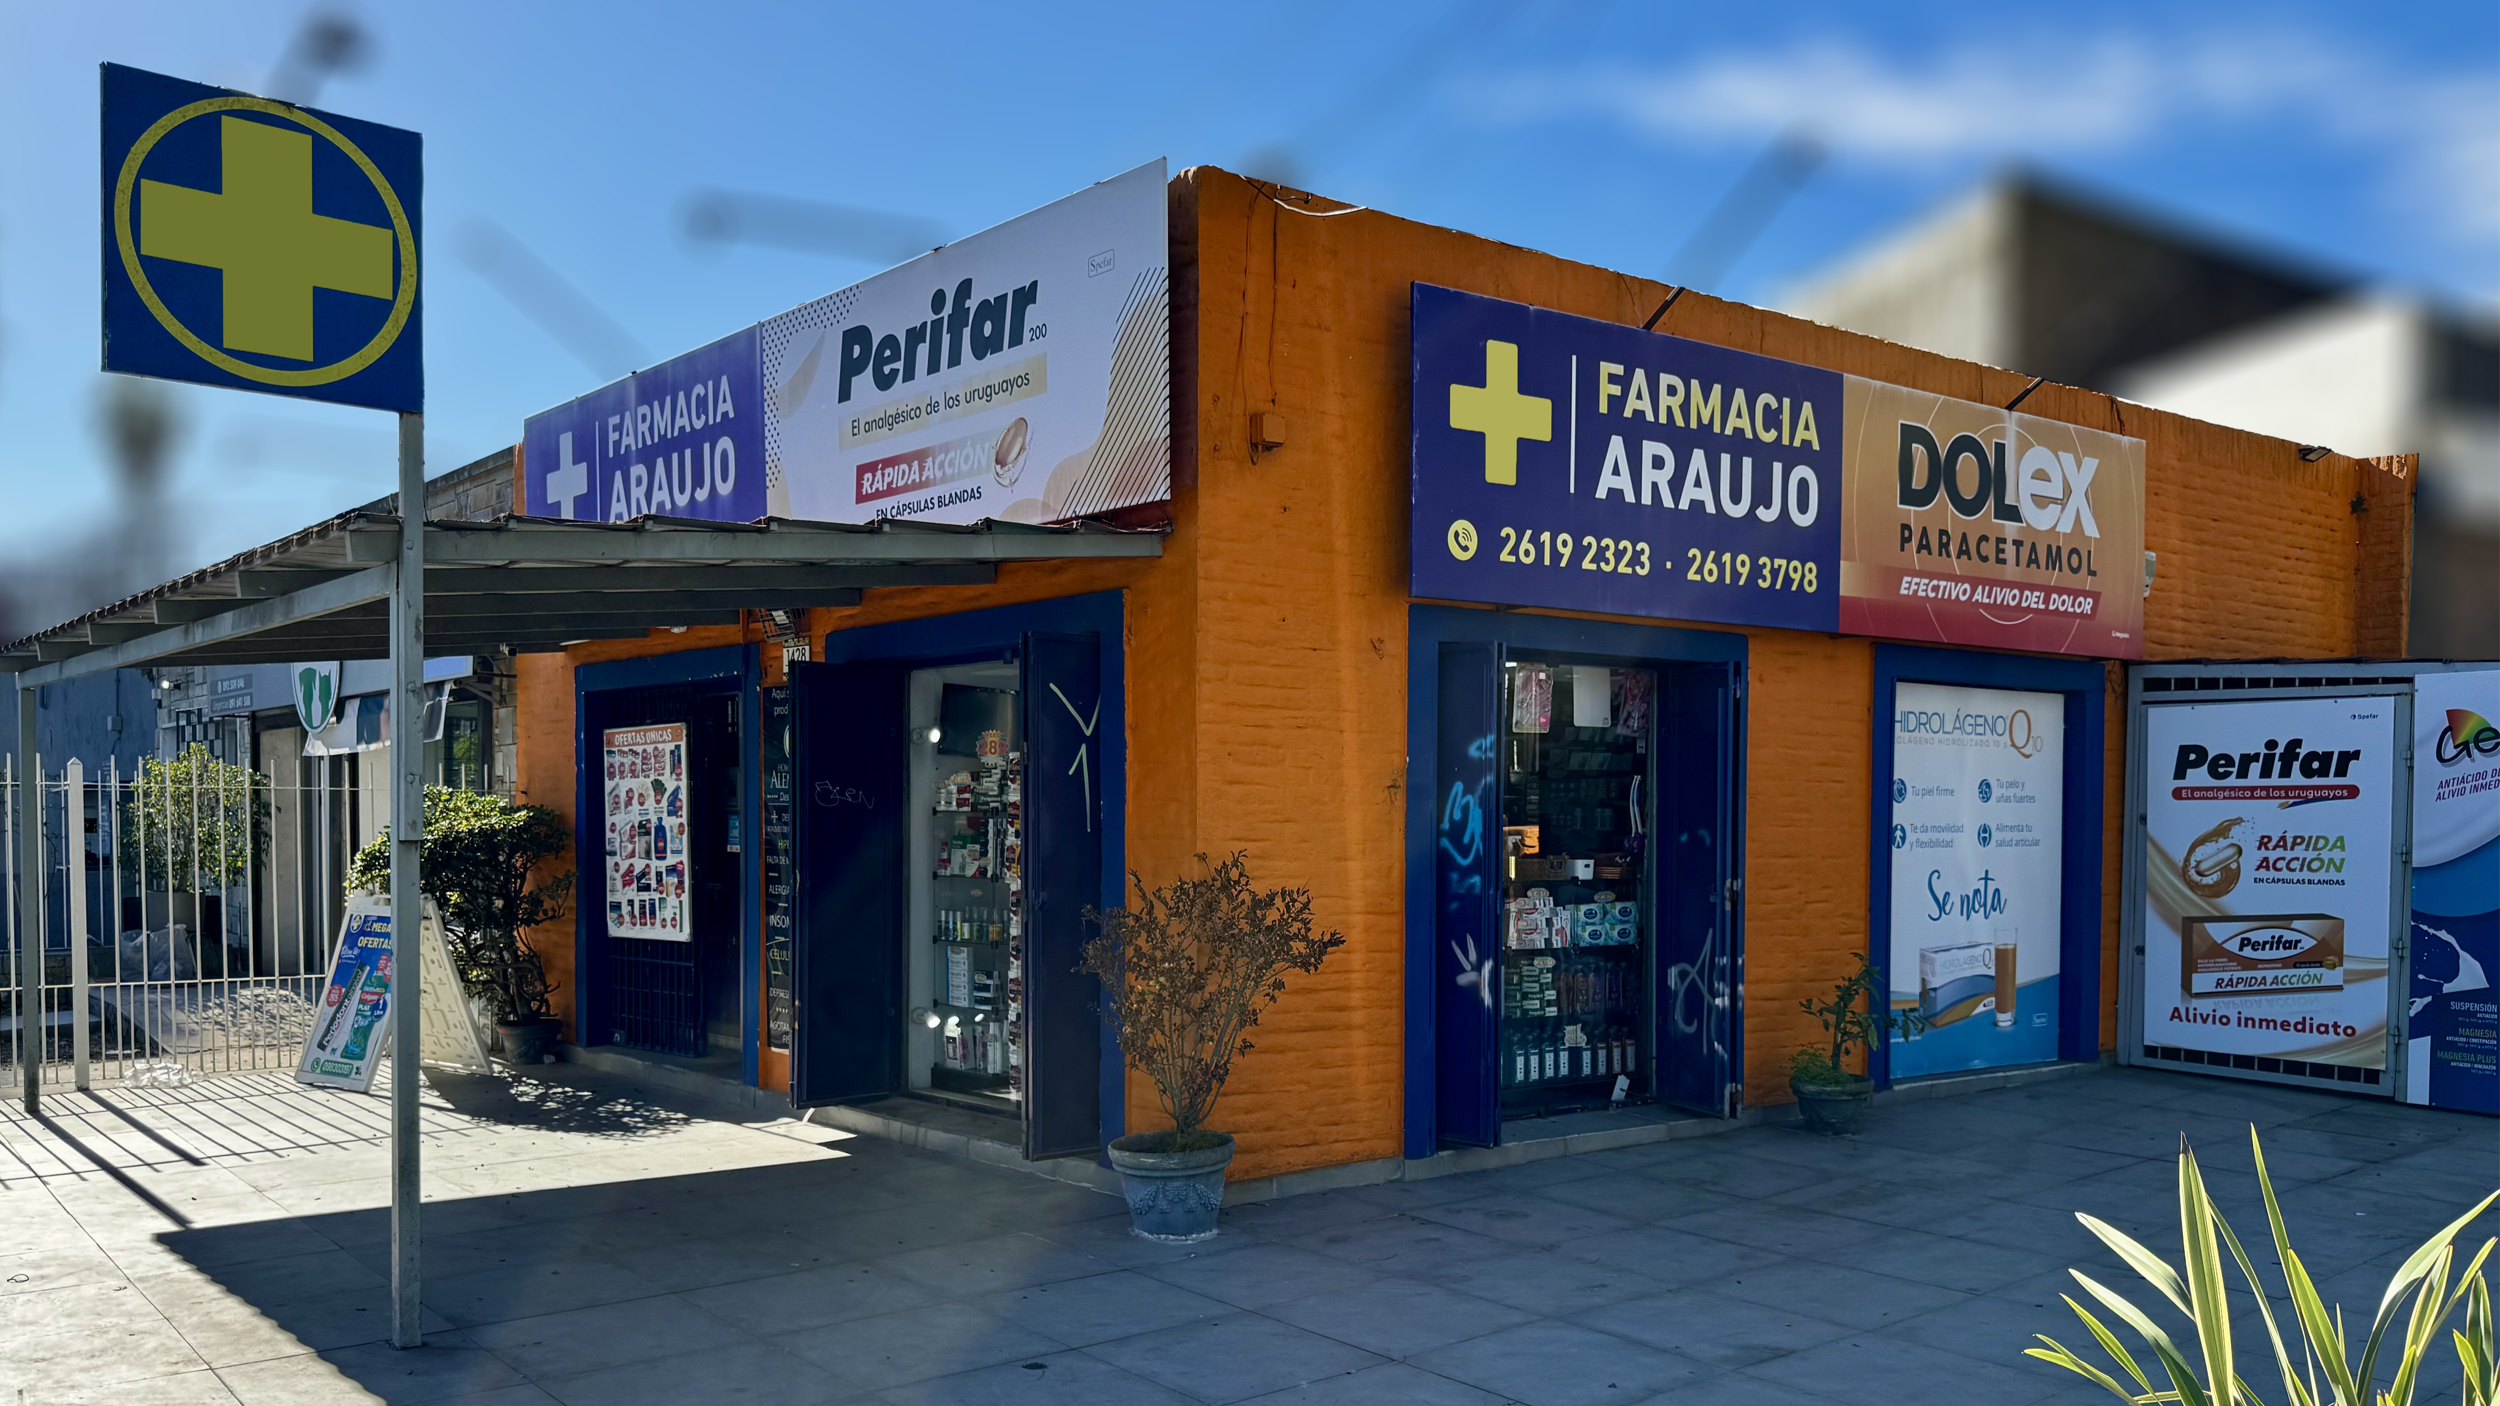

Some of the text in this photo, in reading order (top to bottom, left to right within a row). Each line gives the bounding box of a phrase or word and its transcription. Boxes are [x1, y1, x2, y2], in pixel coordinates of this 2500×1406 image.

[838, 278, 1039, 404] Perifar
[1028, 323, 1047, 342] 200
[851, 372, 1030, 437] El analgésico de los uruguayos
[1599, 361, 1820, 451] FARMACIA
[608, 375, 735, 458] FARMACIA
[861, 440, 990, 495] RÁPIDA ACCIÓN
[610, 436, 735, 523] ARAUJO
[1595, 435, 1819, 527] ARAUJO
[876, 486, 982, 519] EN CÁPSULAS BLANDAS
[1900, 523, 2097, 577] PARACETAMOL
[1500, 526, 1818, 594] 2619 2323 2619 3798
[1900, 576, 2093, 614] EFECTIVO ALIVIO DEL DOLOR
[785, 647, 807, 660] 1428
[1895, 708, 2007, 737] HIDROLÁGENO
[615, 732, 646, 745] OFERTAS
[1896, 735, 1934, 745] OLÁGENO
[2173, 739, 2361, 780] Perifar
[1996, 779, 2025, 791] Tu pelo y
[2437, 770, 2488, 790] ANTIÁCIDO
[1911, 786, 1954, 798] Tu piel firme
[1996, 794, 2035, 803] uñas fuertes
[2181, 788, 2348, 799] El analgésico de los uruguayos
[2435, 786, 2466, 802] ALIVIO
[1910, 824, 1964, 833] Te da movilidad
[1995, 823, 2032, 833] Alimenta tu
[1910, 839, 1953, 851] y flexibilidad
[1995, 837, 2040, 847] salud articular
[2256, 831, 2346, 852] RÁPIDA
[2254, 853, 2345, 873] ACCIÓN
[2266, 876, 2306, 885] CÁPSULAS
[1927, 869, 2007, 921] Se nota
[372, 922, 391, 933] MEGA
[2238, 935, 2302, 952] Perifar
[2215, 971, 2323, 989] RÁPIDA ACCIÓN
[2450, 1001, 2497, 1012] SUSPENSIÓN
[323, 999, 350, 1045] Periodont
[2169, 1007, 2356, 1037] Alivio inmediato
[2459, 1028, 2497, 1038] MAGNESIA
[2438, 1051, 2496, 1064] MAGNESIA PLUS
